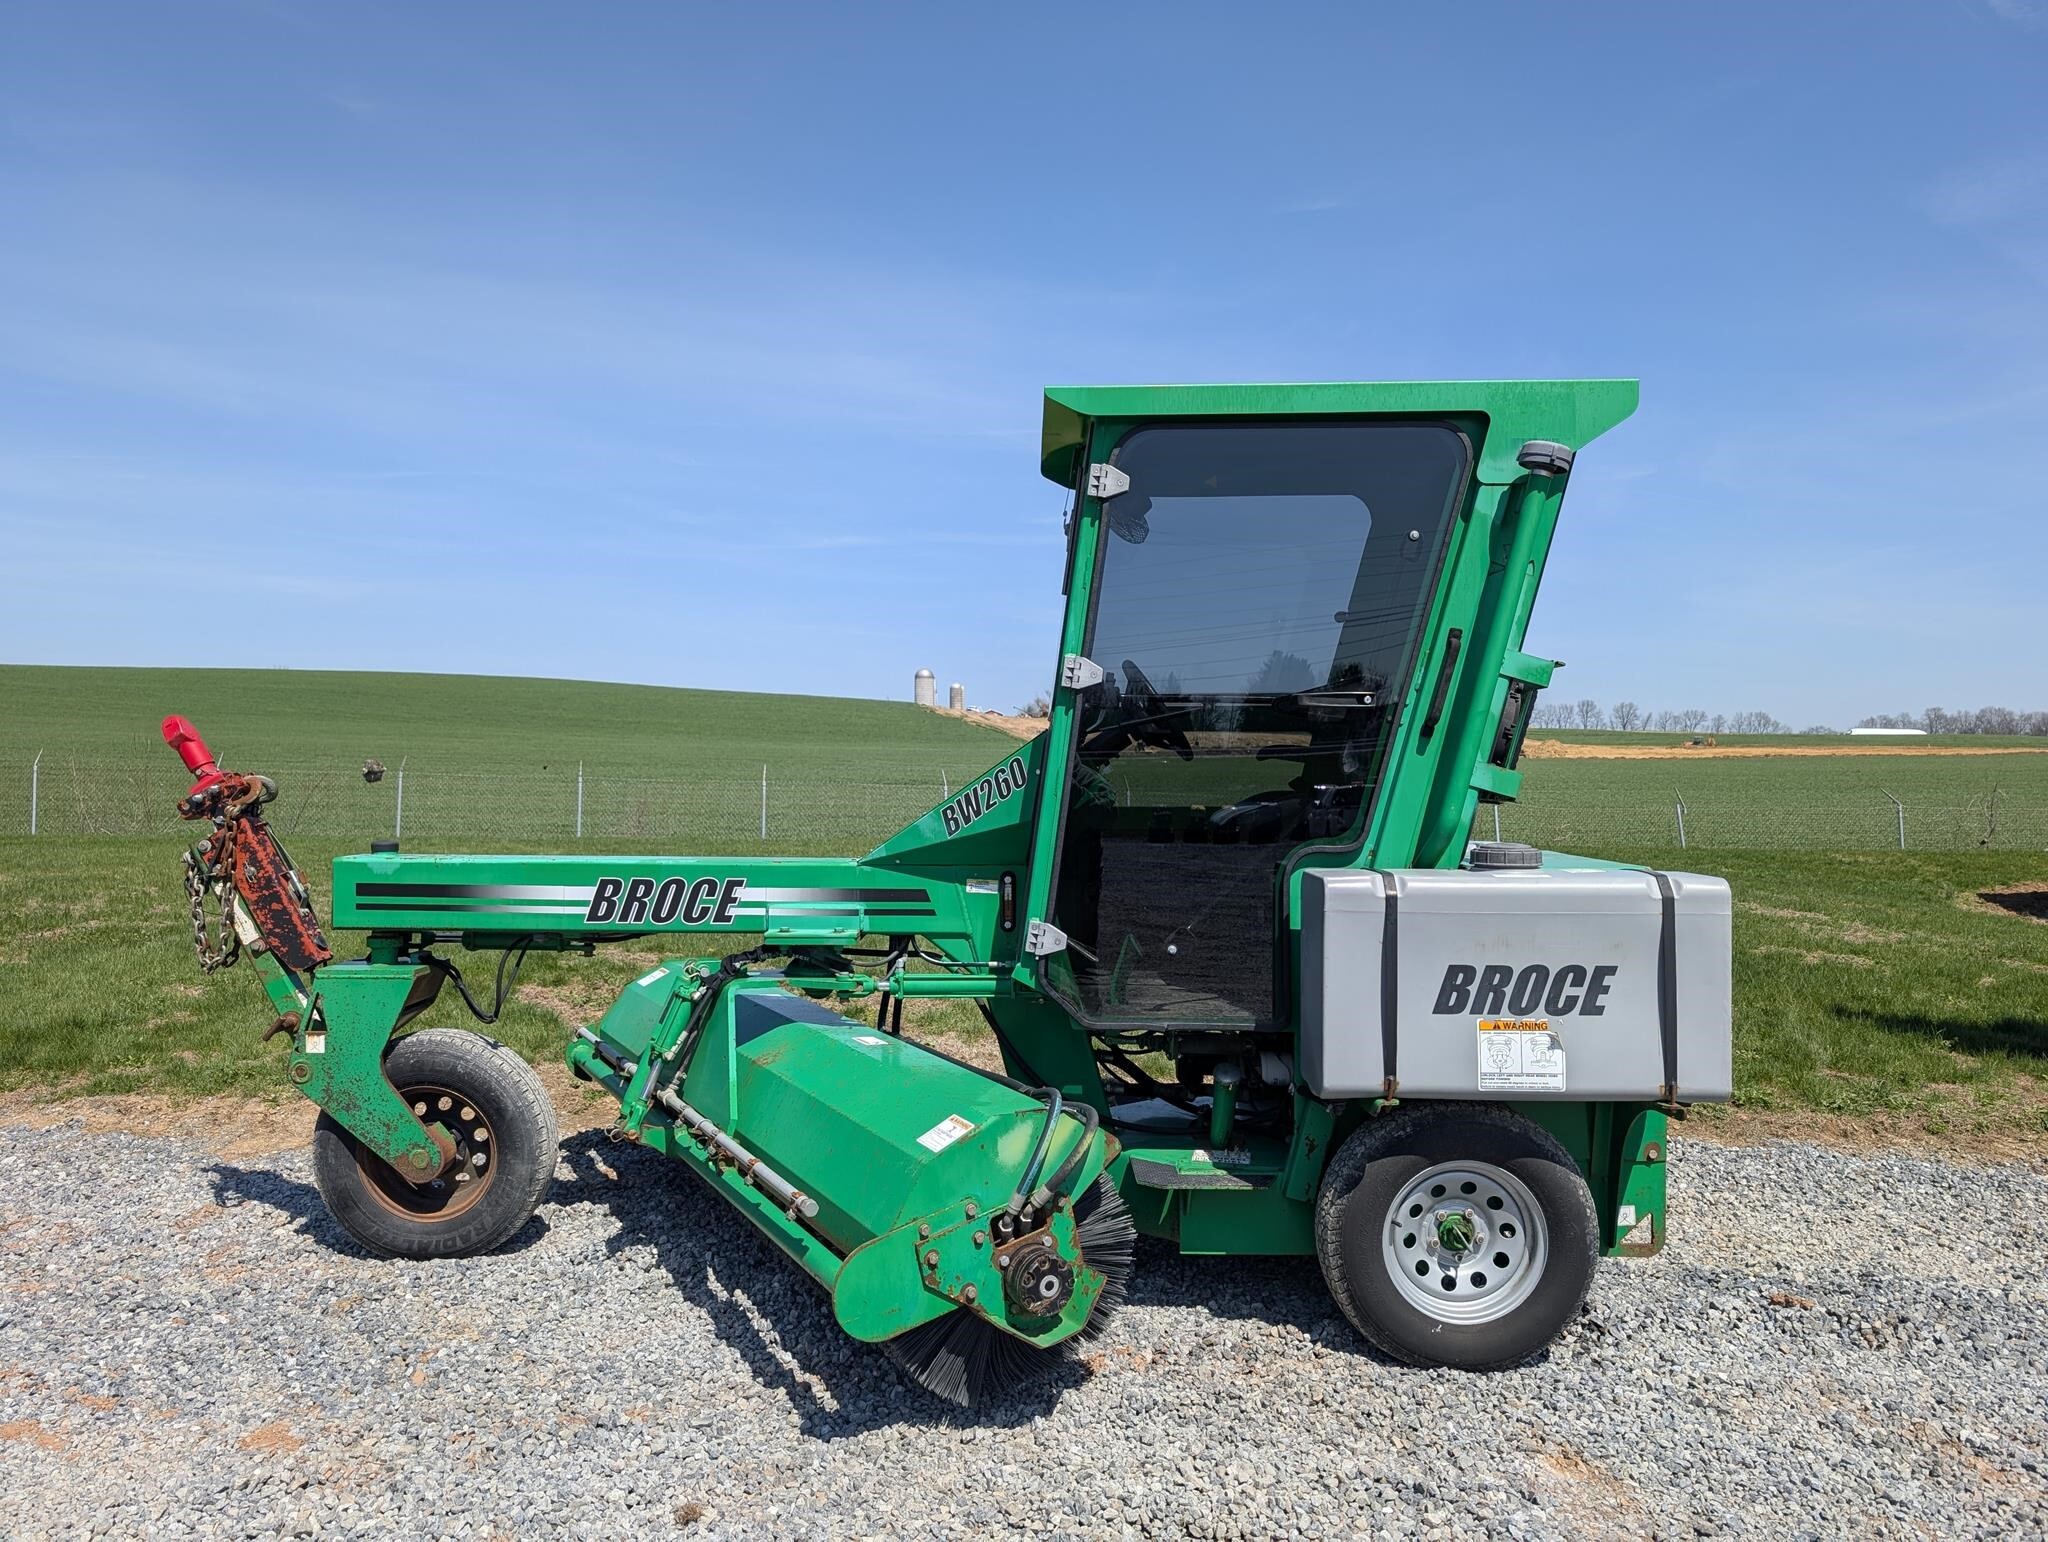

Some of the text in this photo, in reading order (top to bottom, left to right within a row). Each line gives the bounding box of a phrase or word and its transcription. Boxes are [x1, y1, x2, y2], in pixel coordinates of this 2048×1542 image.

[940, 756, 1028, 838] BW260
[584, 877, 747, 925] BROCE
[1432, 964, 1618, 1016] BROCE
[1503, 1022, 1548, 1031] WARNING
